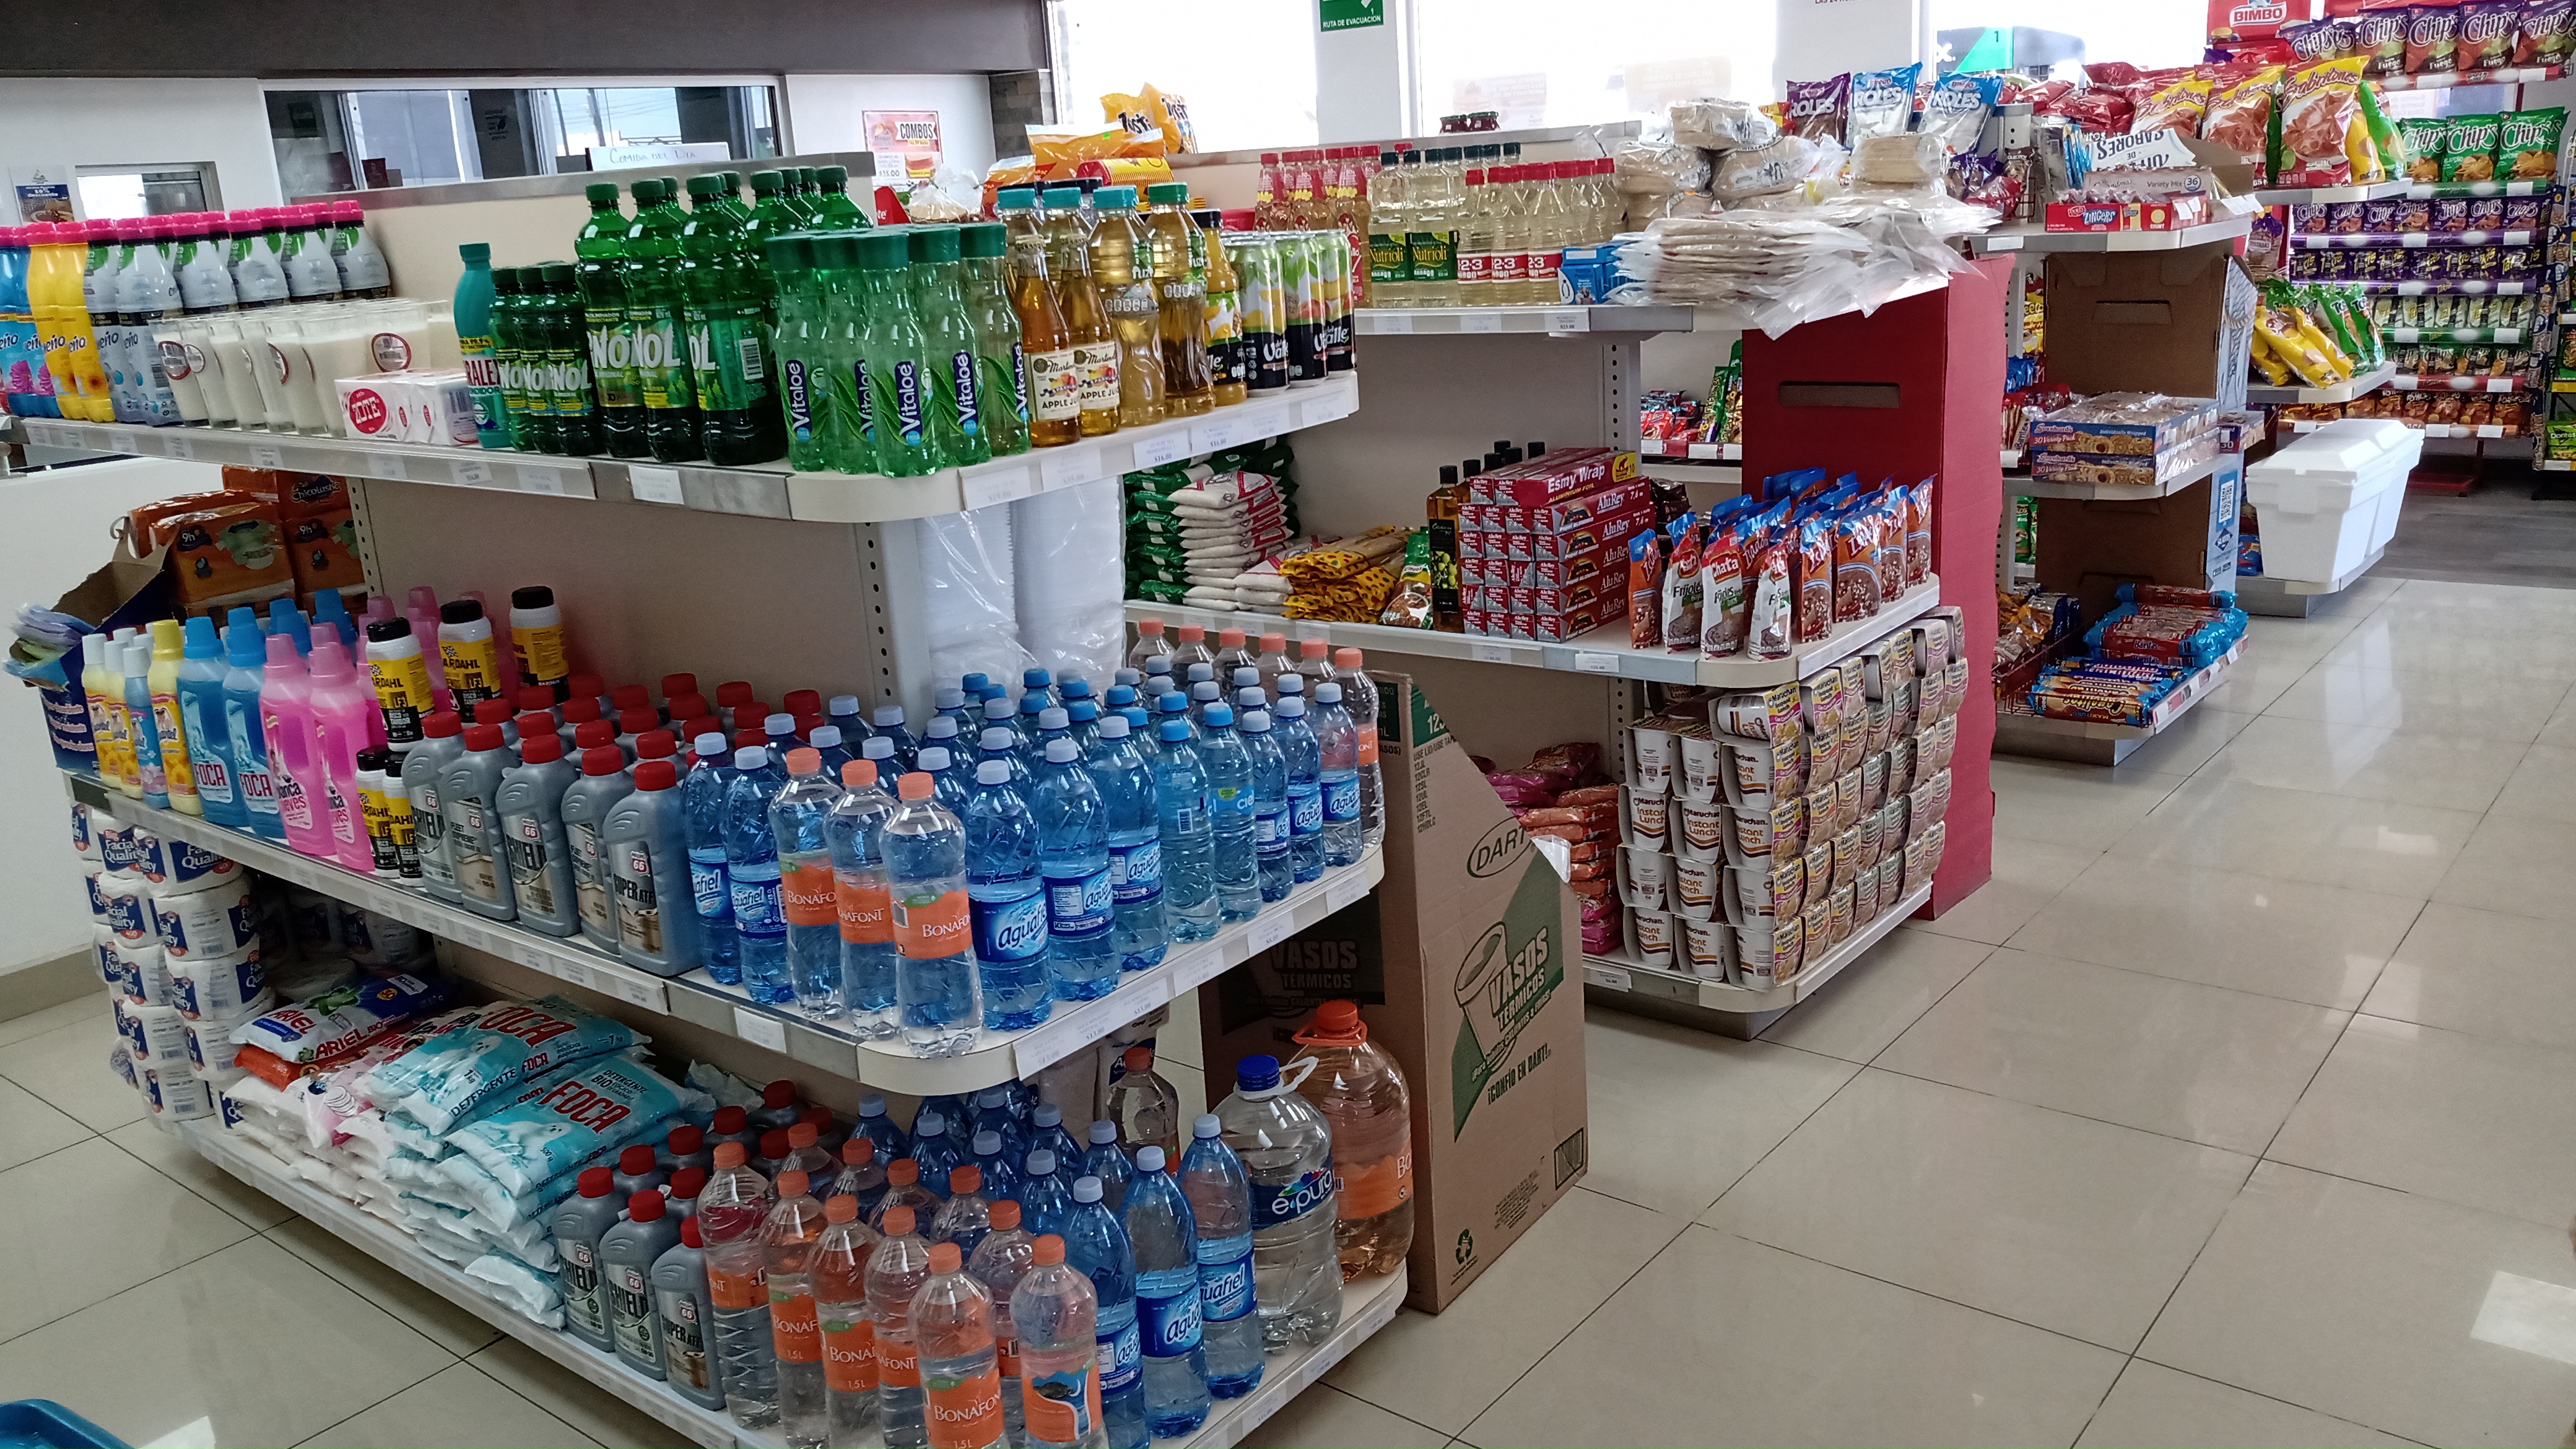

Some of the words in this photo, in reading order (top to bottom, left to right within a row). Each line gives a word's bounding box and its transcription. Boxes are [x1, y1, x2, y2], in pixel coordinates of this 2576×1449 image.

[2234, 7, 2283, 22] BIMBO
[1323, 20, 1337, 28] RUTA
[1853, 86, 1902, 108] ROLES
[1931, 91, 1982, 110] ROLES
[900, 123, 934, 139] COMBOS
[2448, 124, 2499, 154] Chip's
[610, 148, 649, 164] COMIDA
[651, 152, 667, 161] DEL
[2147, 180, 2170, 188] Variety
[2187, 176, 2199, 185] 36
[1412, 245, 1448, 262] Nutrioli
[1080, 391, 1106, 400] APPLE
[1042, 401, 1068, 410] APPLE
[1548, 474, 1577, 494] Esmy
[1579, 464, 1605, 482] Wrap
[1712, 557, 1739, 578] Chata
[194, 764, 227, 786] FOCA
[239, 773, 272, 797] FOCA
[525, 826, 537, 837] 66
[1687, 819, 1719, 829] Instant
[1475, 826, 1527, 872] DART
[633, 859, 646, 871] 66
[1271, 940, 1358, 970] VASOS
[1487, 926, 1549, 1019] VASOS
[315, 1029, 367, 1060] ARIEL
[521, 1052, 550, 1074] FOCA
[450, 1068, 516, 1118] DETERGENTE
[535, 1079, 632, 1134] FOCA
[579, 1251, 590, 1263] 66
[630, 1277, 640, 1289] 66
[682, 1308, 693, 1319] 66
